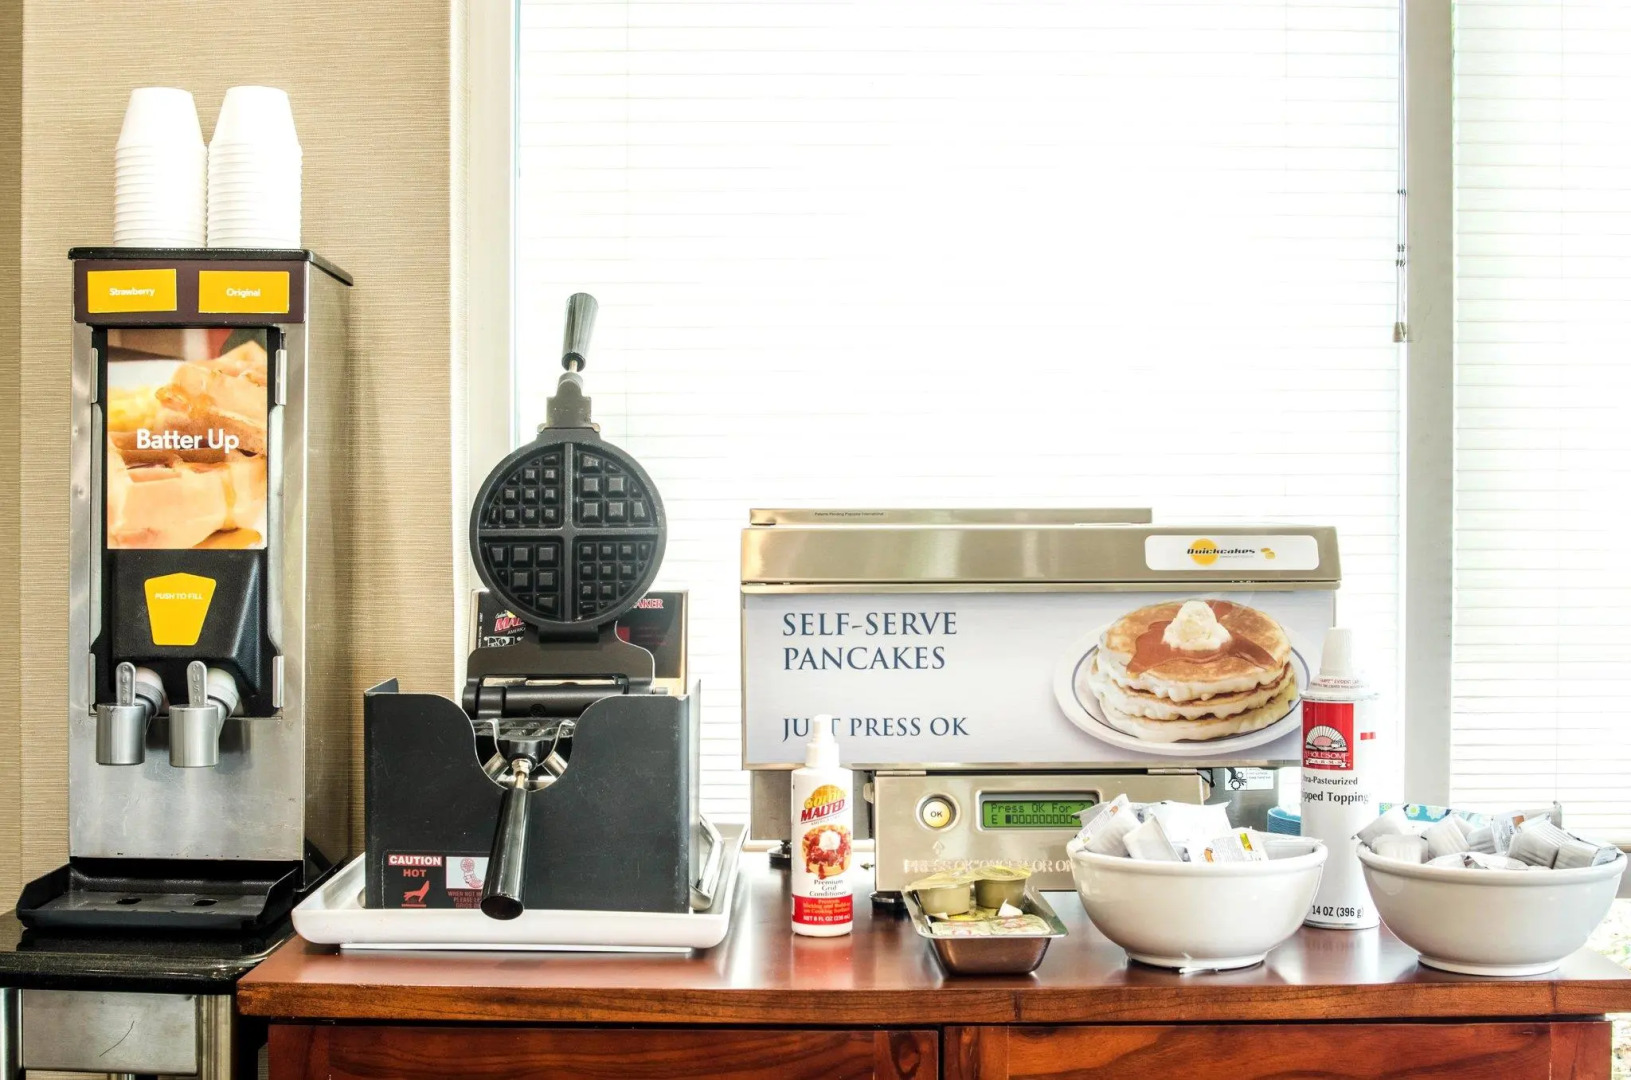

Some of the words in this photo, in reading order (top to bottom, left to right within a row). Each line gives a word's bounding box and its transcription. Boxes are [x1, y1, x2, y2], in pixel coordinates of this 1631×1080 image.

[109, 287, 155, 297] Strawberry
[226, 287, 261, 298] Original
[136, 428, 203, 450] Batter
[208, 428, 240, 454] Up
[154, 592, 174, 600] PUSH
[175, 592, 187, 600] TO
[188, 592, 203, 600] FILL
[634, 598, 665, 609] AKER
[494, 616, 525, 633] MAL
[783, 612, 958, 636] SELF-SERVE
[784, 646, 945, 671] PANCAKES
[782, 717, 841, 742] JUT
[849, 717, 921, 737] PRESS
[930, 716, 970, 736] OK
[1327, 791, 1369, 806] Topping
[801, 798, 845, 822] MALTED
[991, 803, 1025, 813] Press
[1032, 803, 1046, 813] OK
[1052, 803, 1072, 813] For
[930, 810, 943, 819] OK
[991, 814, 998, 825] E
[389, 855, 442, 866] CAUTION
[403, 869, 427, 878] HOT
[1312, 905, 1321, 915] 14
[1323, 906, 1334, 917] OZ
[1336, 907, 1355, 918] (396
